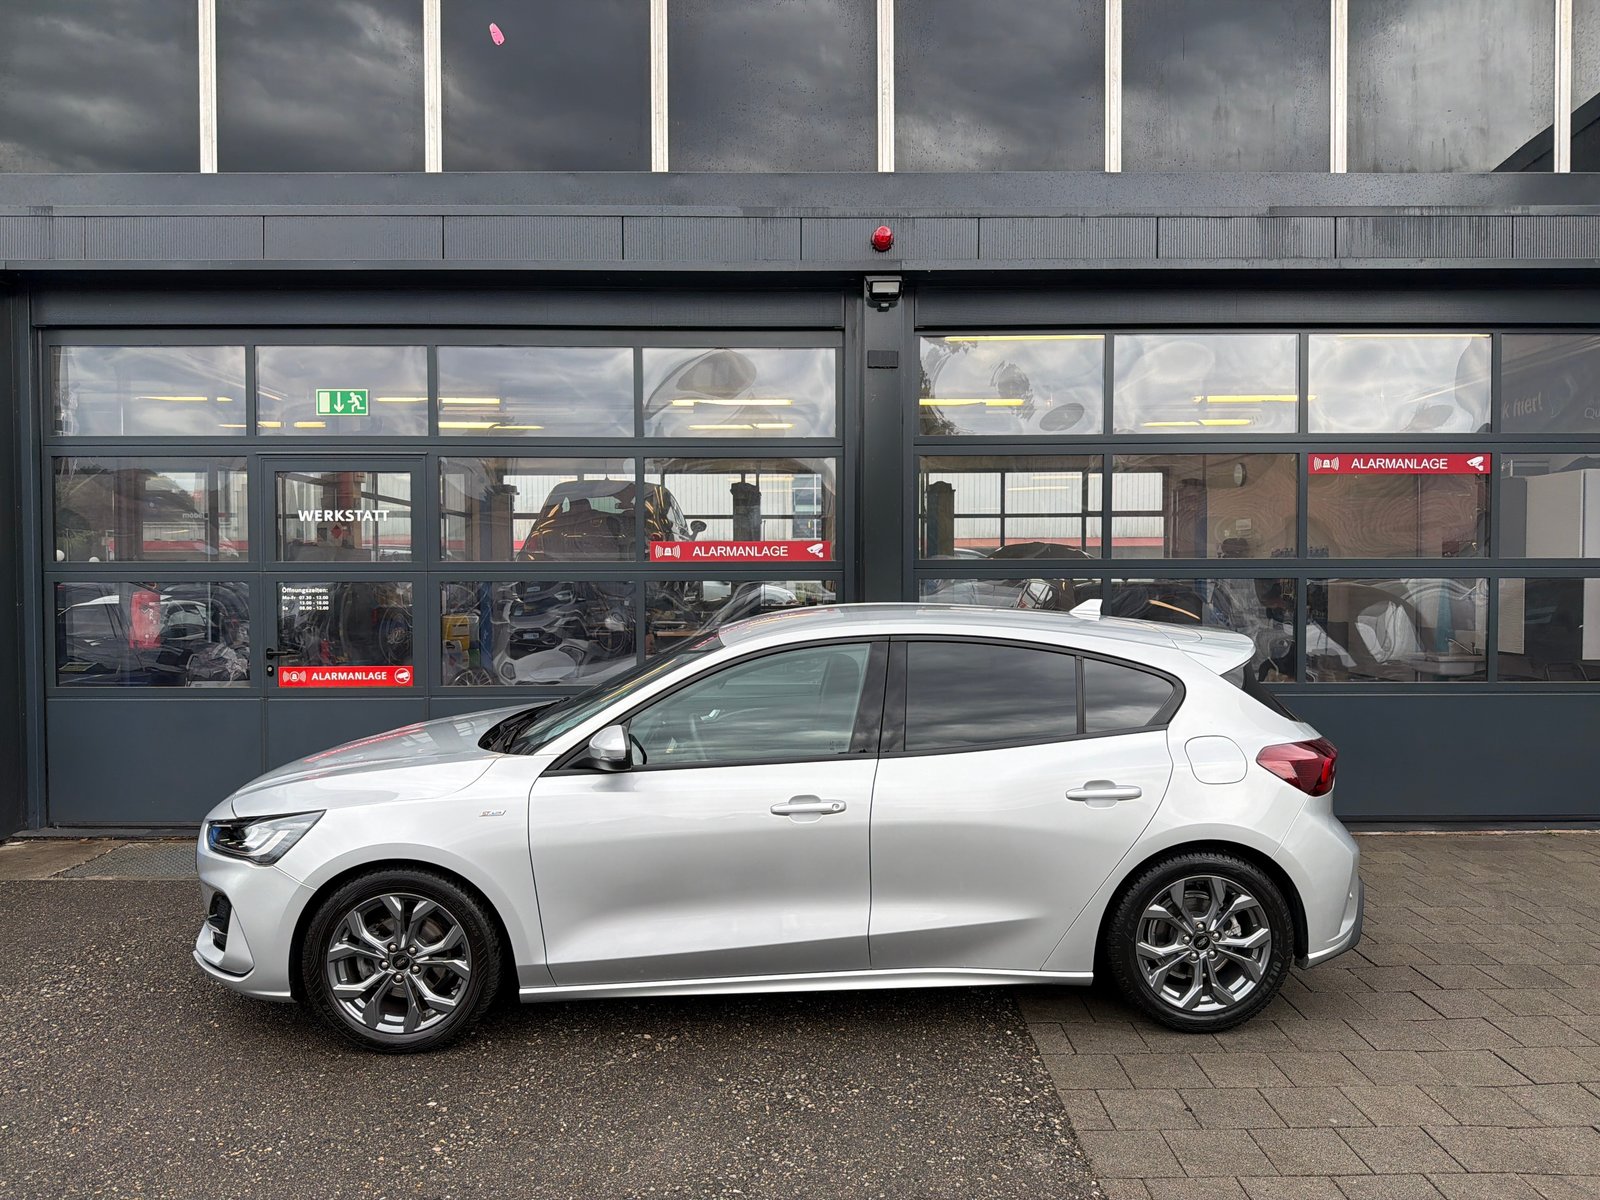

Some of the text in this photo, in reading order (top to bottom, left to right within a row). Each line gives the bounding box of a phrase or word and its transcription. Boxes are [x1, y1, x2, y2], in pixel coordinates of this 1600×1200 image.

[1351, 458, 1449, 470] ALARMANLAGE
[297, 509, 390, 522] WERKSTATT
[692, 545, 789, 557] ALARMANLAGE
[311, 671, 387, 681] ALARMANLAGE
